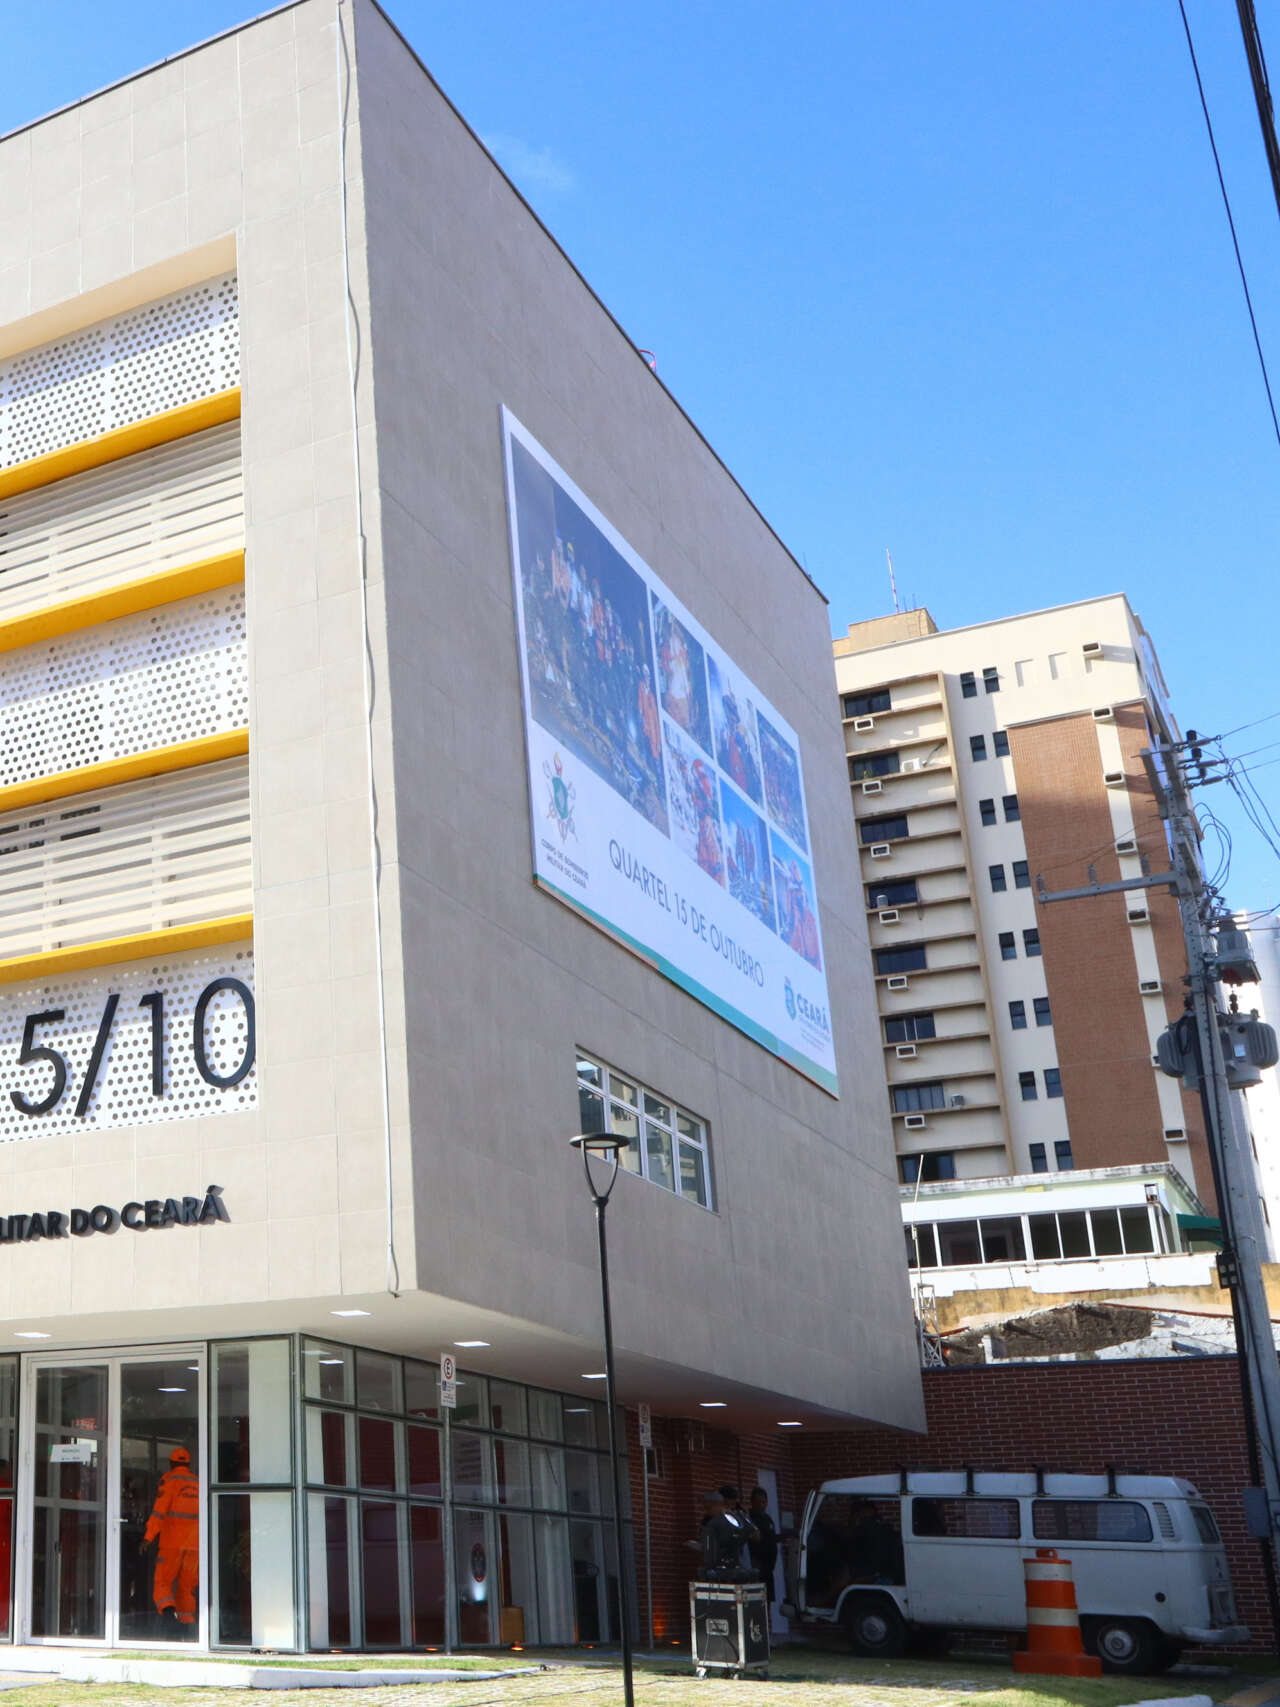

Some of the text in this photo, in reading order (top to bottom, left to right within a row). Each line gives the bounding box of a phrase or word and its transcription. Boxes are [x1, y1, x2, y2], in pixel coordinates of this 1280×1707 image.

[609, 839, 764, 988] QUARTEL 15 DE OUTUBRO
[797, 993, 830, 1034] CEARÁ
[70, 1205, 121, 1237] DO
[121, 1184, 231, 1232] CEARÁ
